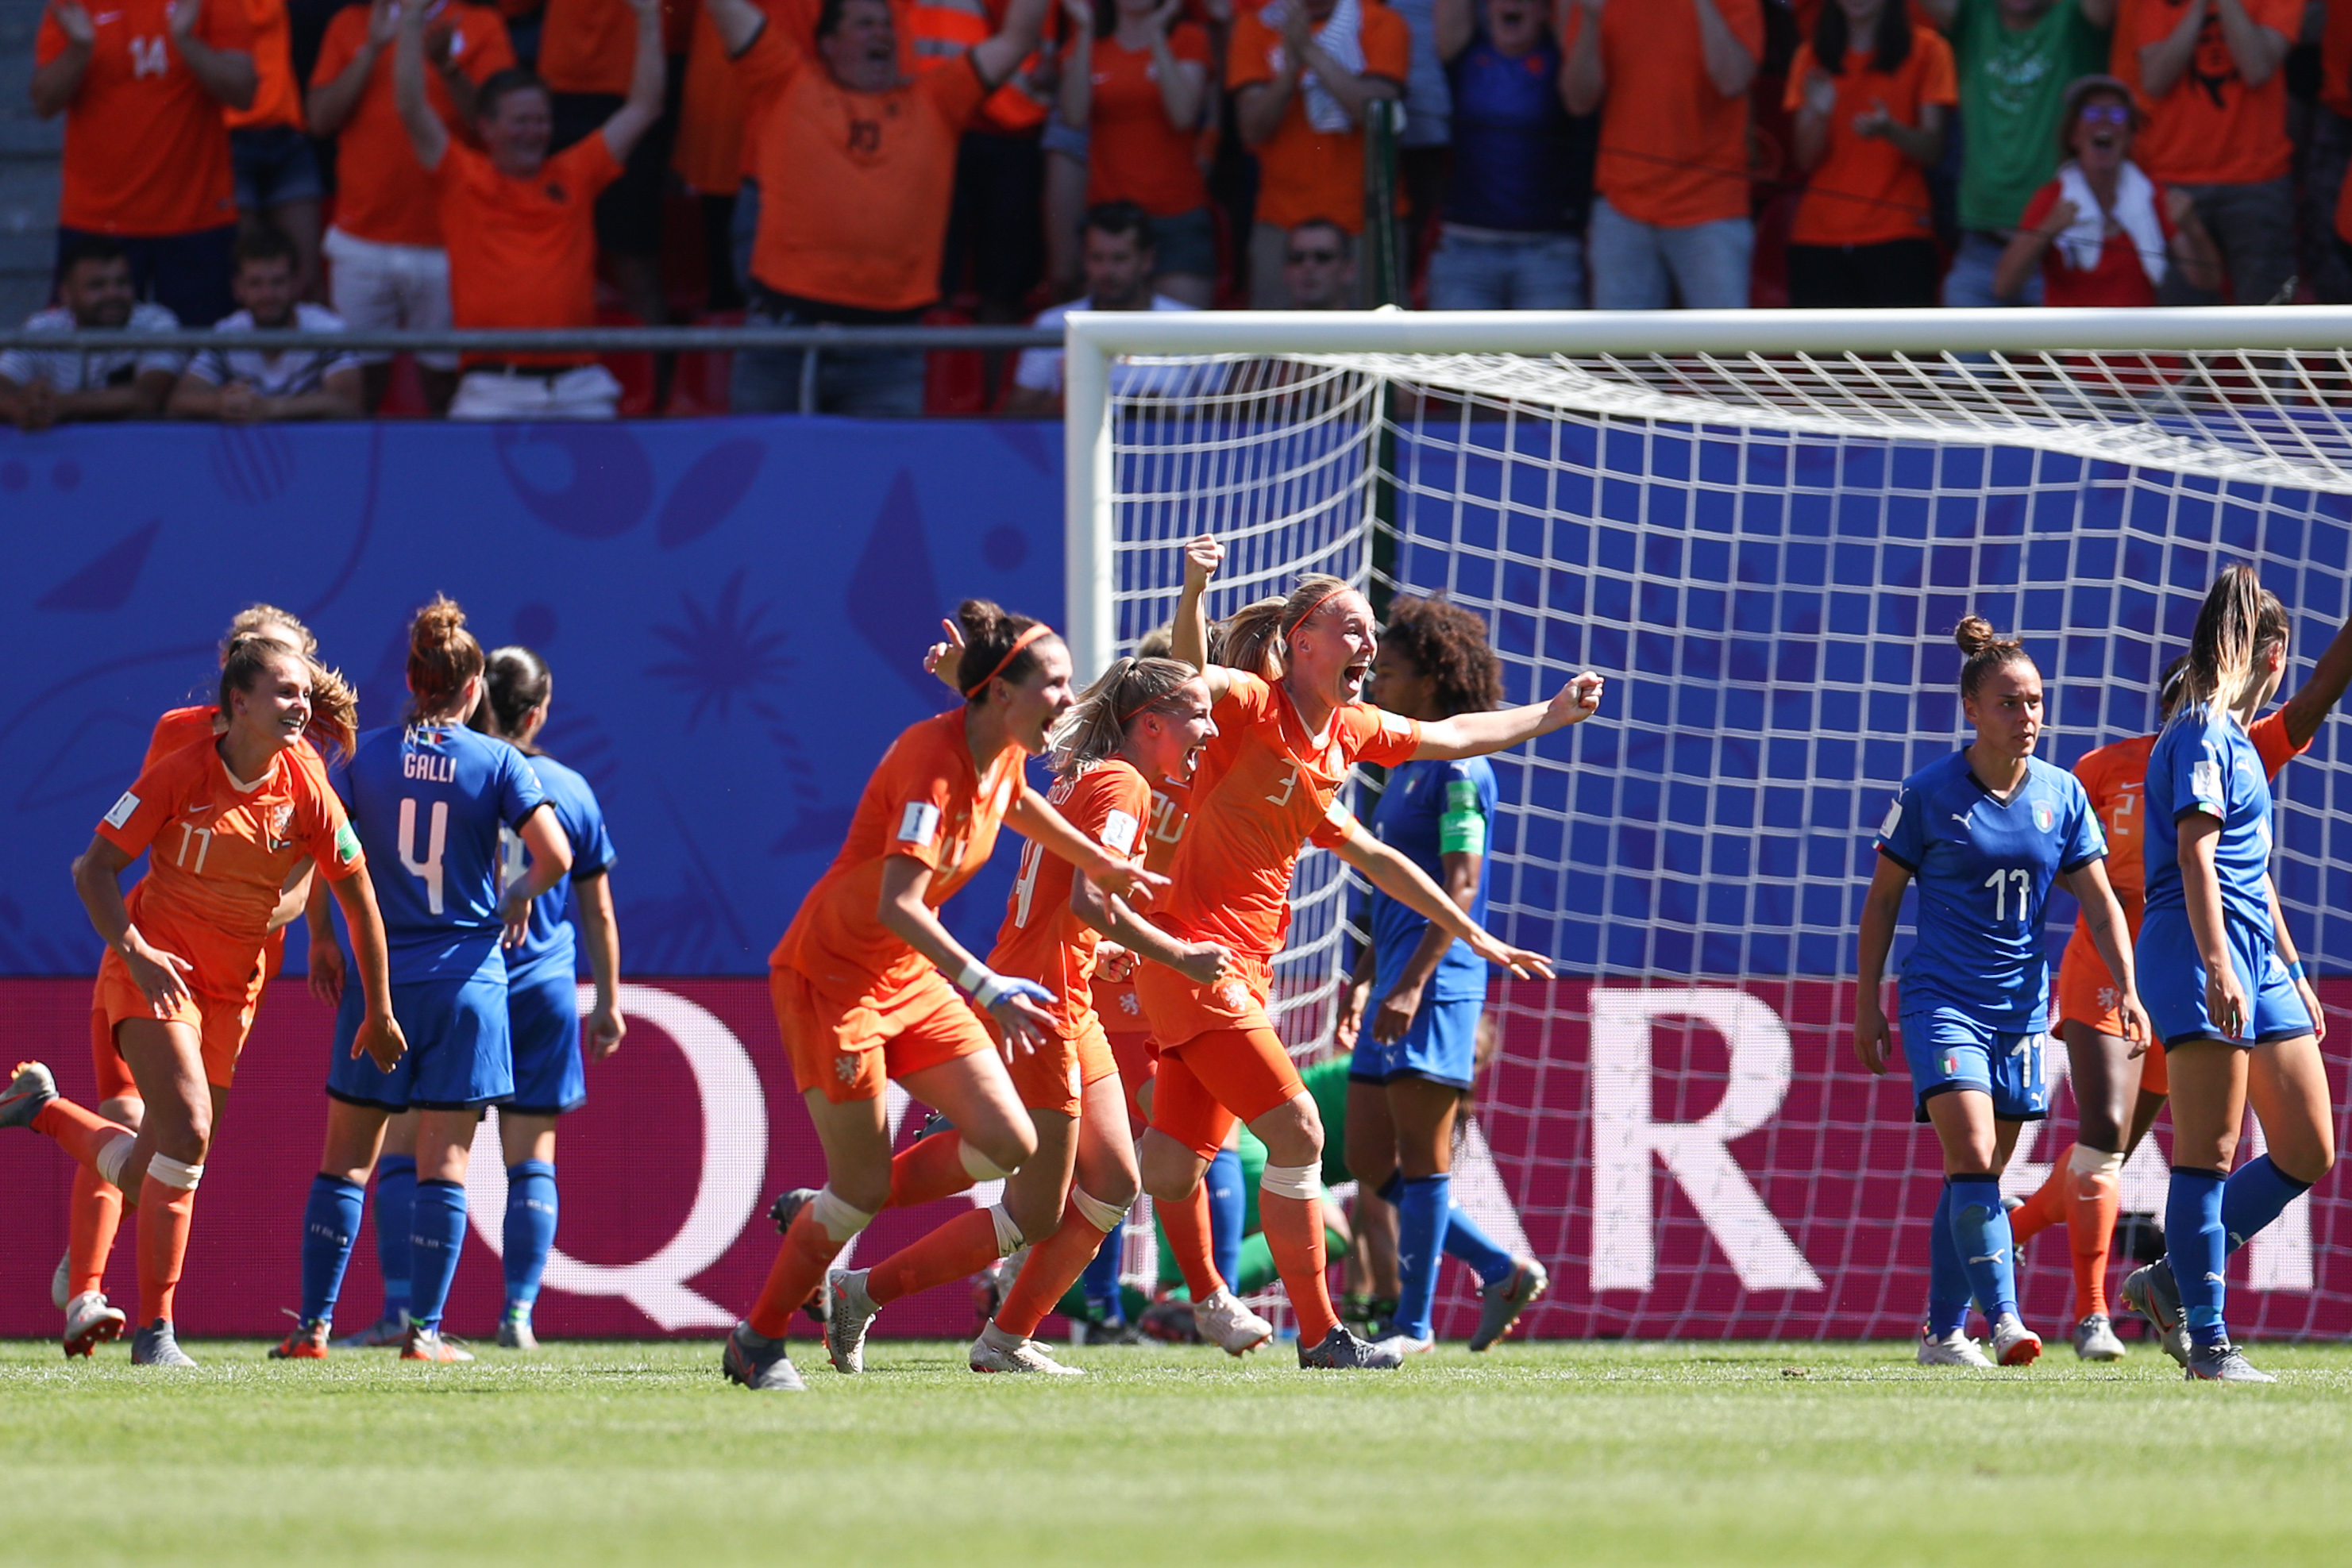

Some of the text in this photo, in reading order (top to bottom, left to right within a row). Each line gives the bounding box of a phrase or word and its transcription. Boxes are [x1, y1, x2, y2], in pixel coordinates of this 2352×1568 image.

[129, 36, 168, 79] 14
[403, 752, 457, 784] GALLI
[1265, 757, 1301, 807] 3
[2113, 793, 2136, 834] 2
[176, 821, 211, 873] 11
[398, 798, 449, 915] 4
